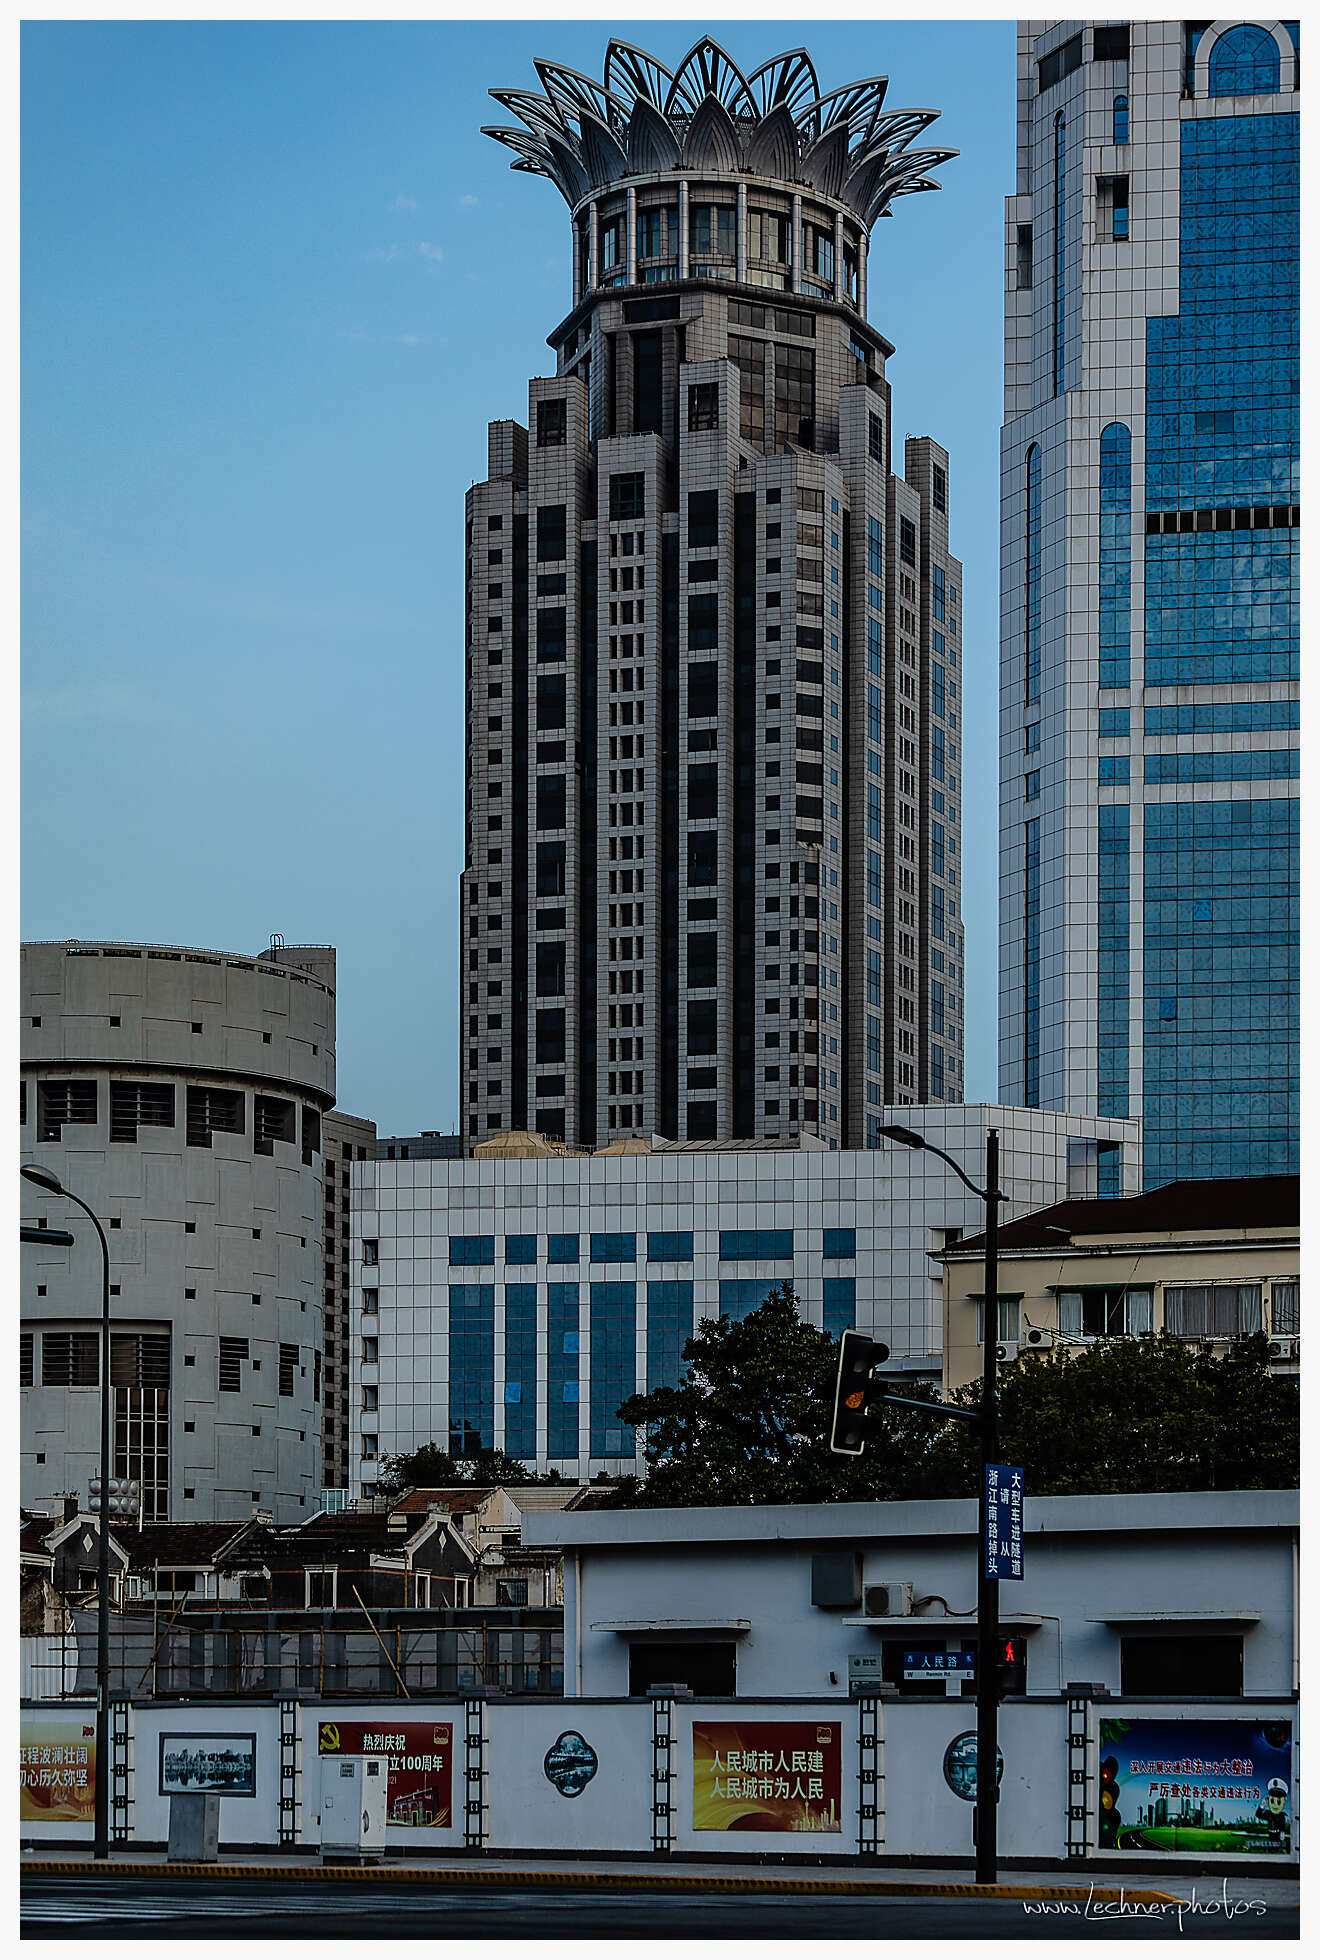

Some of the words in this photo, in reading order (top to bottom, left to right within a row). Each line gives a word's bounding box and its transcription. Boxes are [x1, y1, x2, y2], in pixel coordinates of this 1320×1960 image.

[988, 1469, 998, 1574] 浙江南路掉头
[920, 1655, 957, 1668] 人民路
[363, 1733, 406, 1751] 热烈庆祝
[709, 1749, 824, 1773] 人民城市人民建
[709, 1776, 824, 1800] 人民城市为人民
[1148, 1782, 1261, 1800] 严厉查处各类交通违法行为
